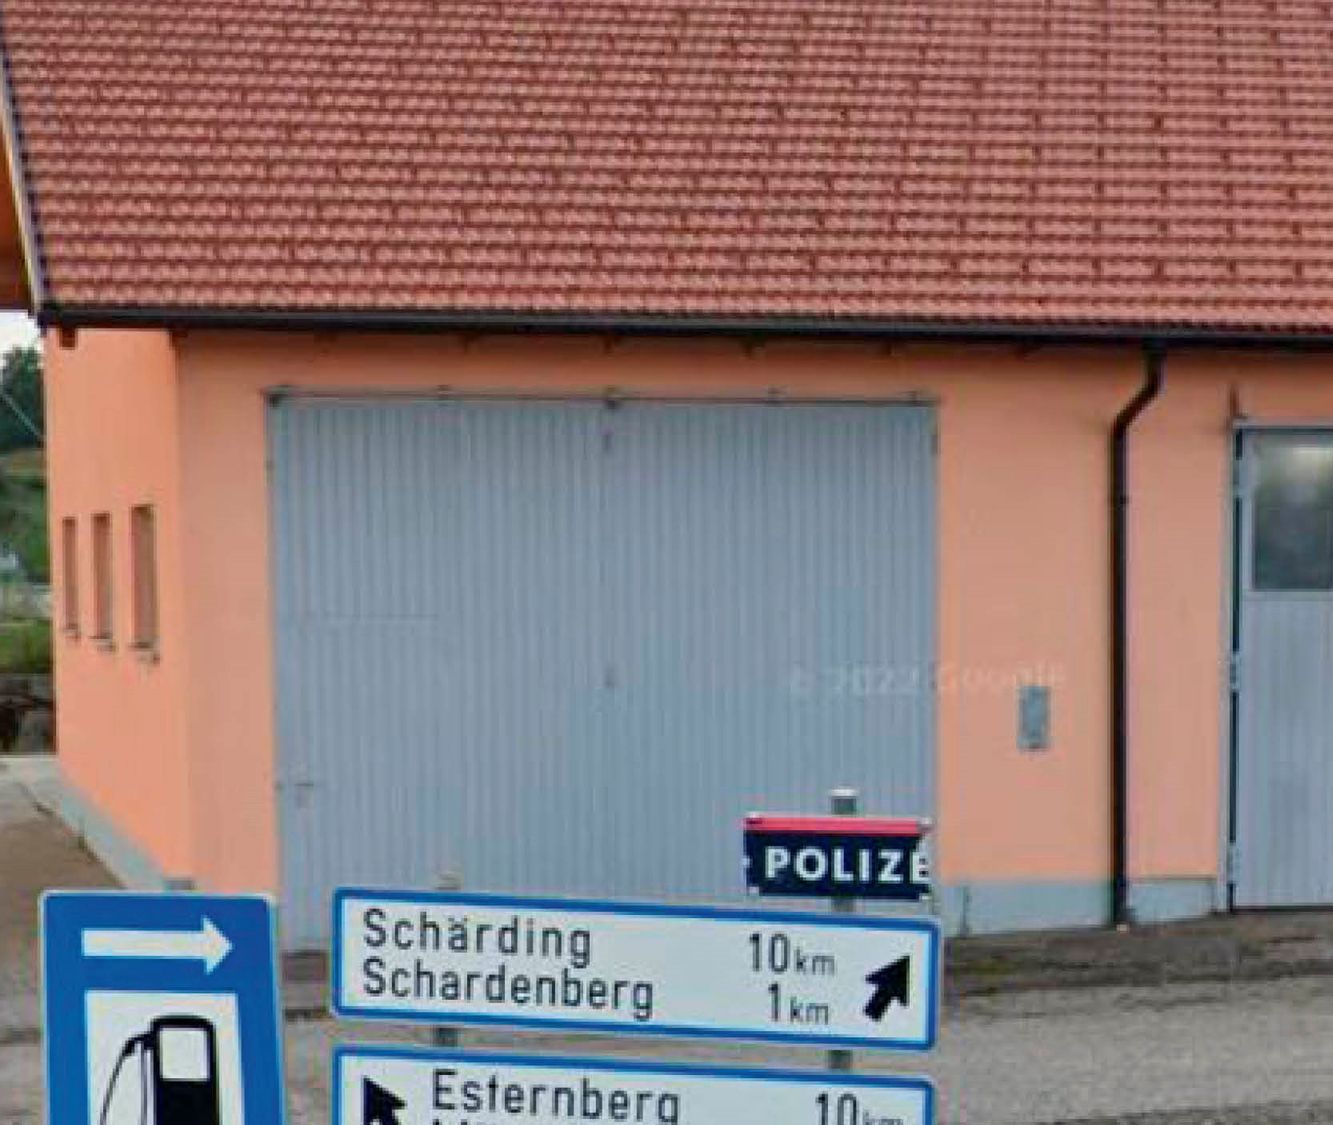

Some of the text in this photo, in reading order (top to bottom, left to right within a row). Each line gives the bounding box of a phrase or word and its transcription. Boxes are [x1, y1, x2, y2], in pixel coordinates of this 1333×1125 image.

[764, 846, 931, 884] POLIZE
[363, 908, 591, 970] Schärding
[363, 955, 654, 1022] Schardenberg
